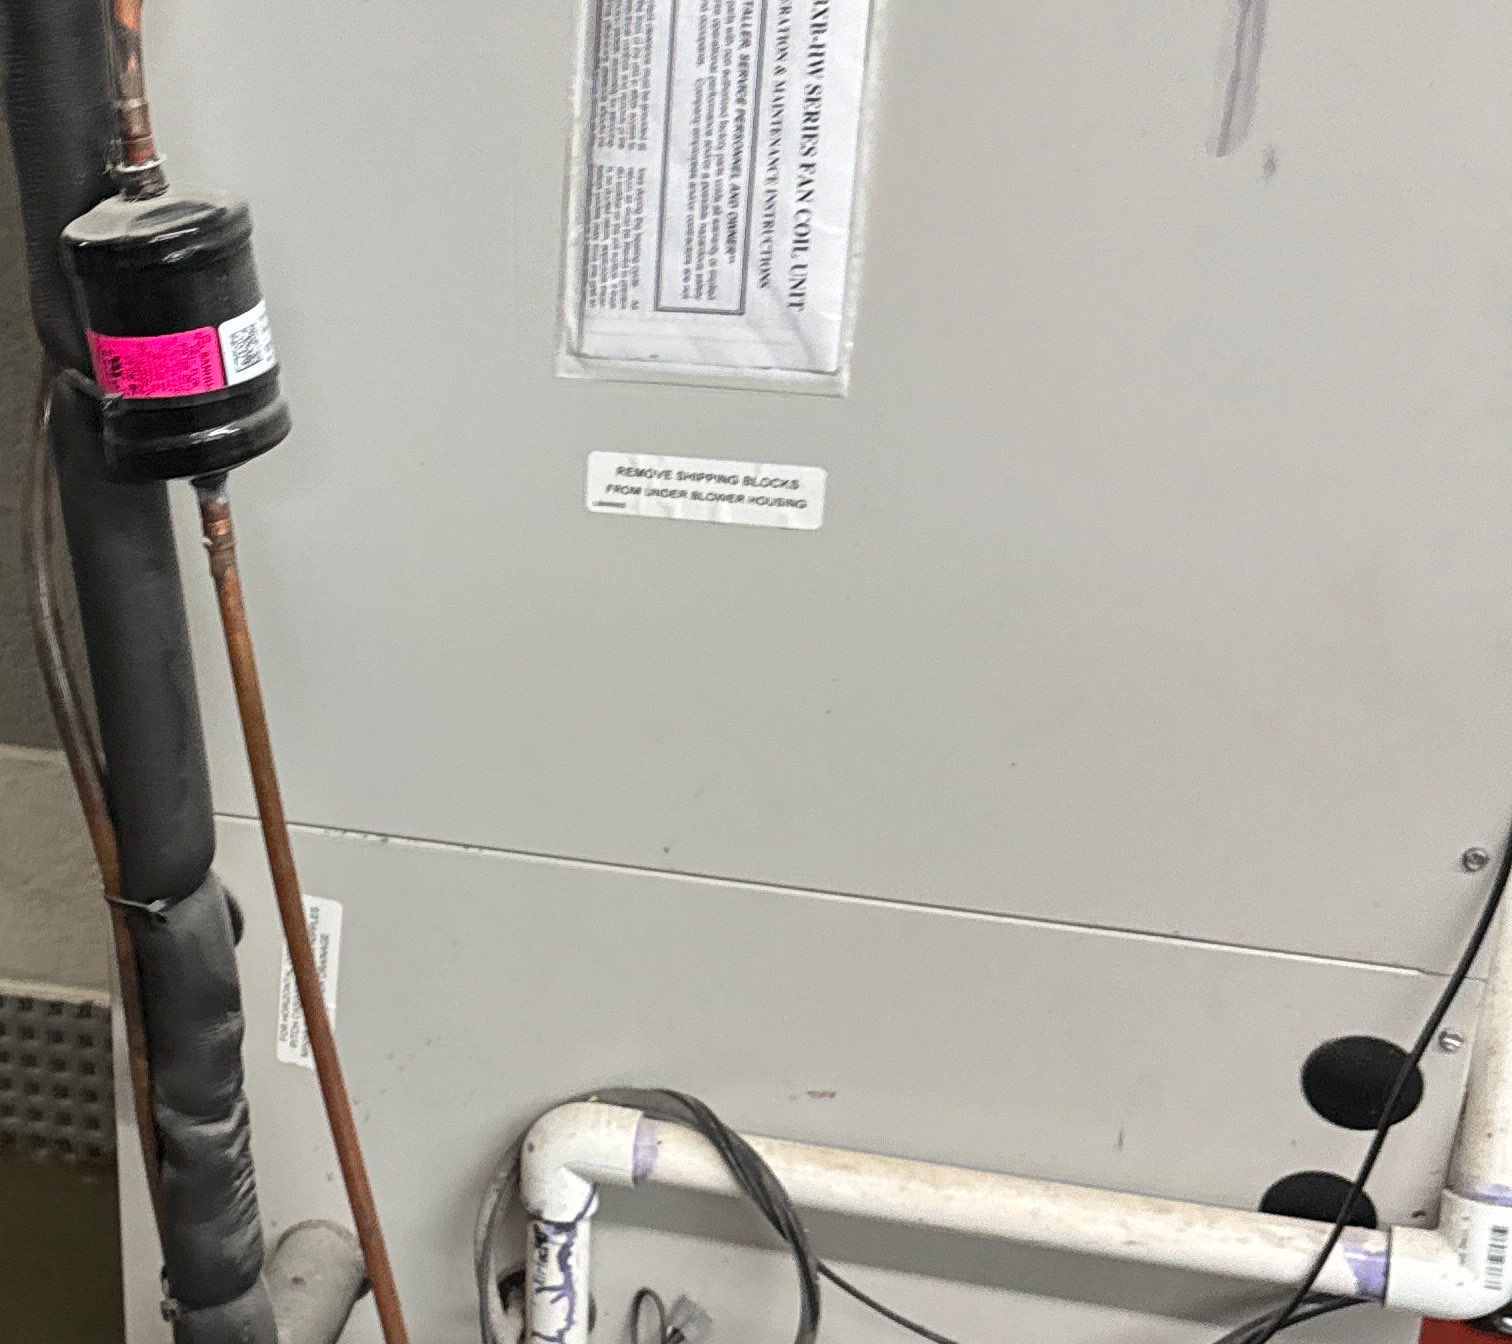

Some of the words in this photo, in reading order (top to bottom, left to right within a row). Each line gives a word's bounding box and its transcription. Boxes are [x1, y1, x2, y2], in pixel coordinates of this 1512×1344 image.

[797, 84, 823, 157] SERIES
[794, 162, 817, 203] FAN
[789, 208, 813, 258] COIL
[785, 263, 809, 312] UNIT
